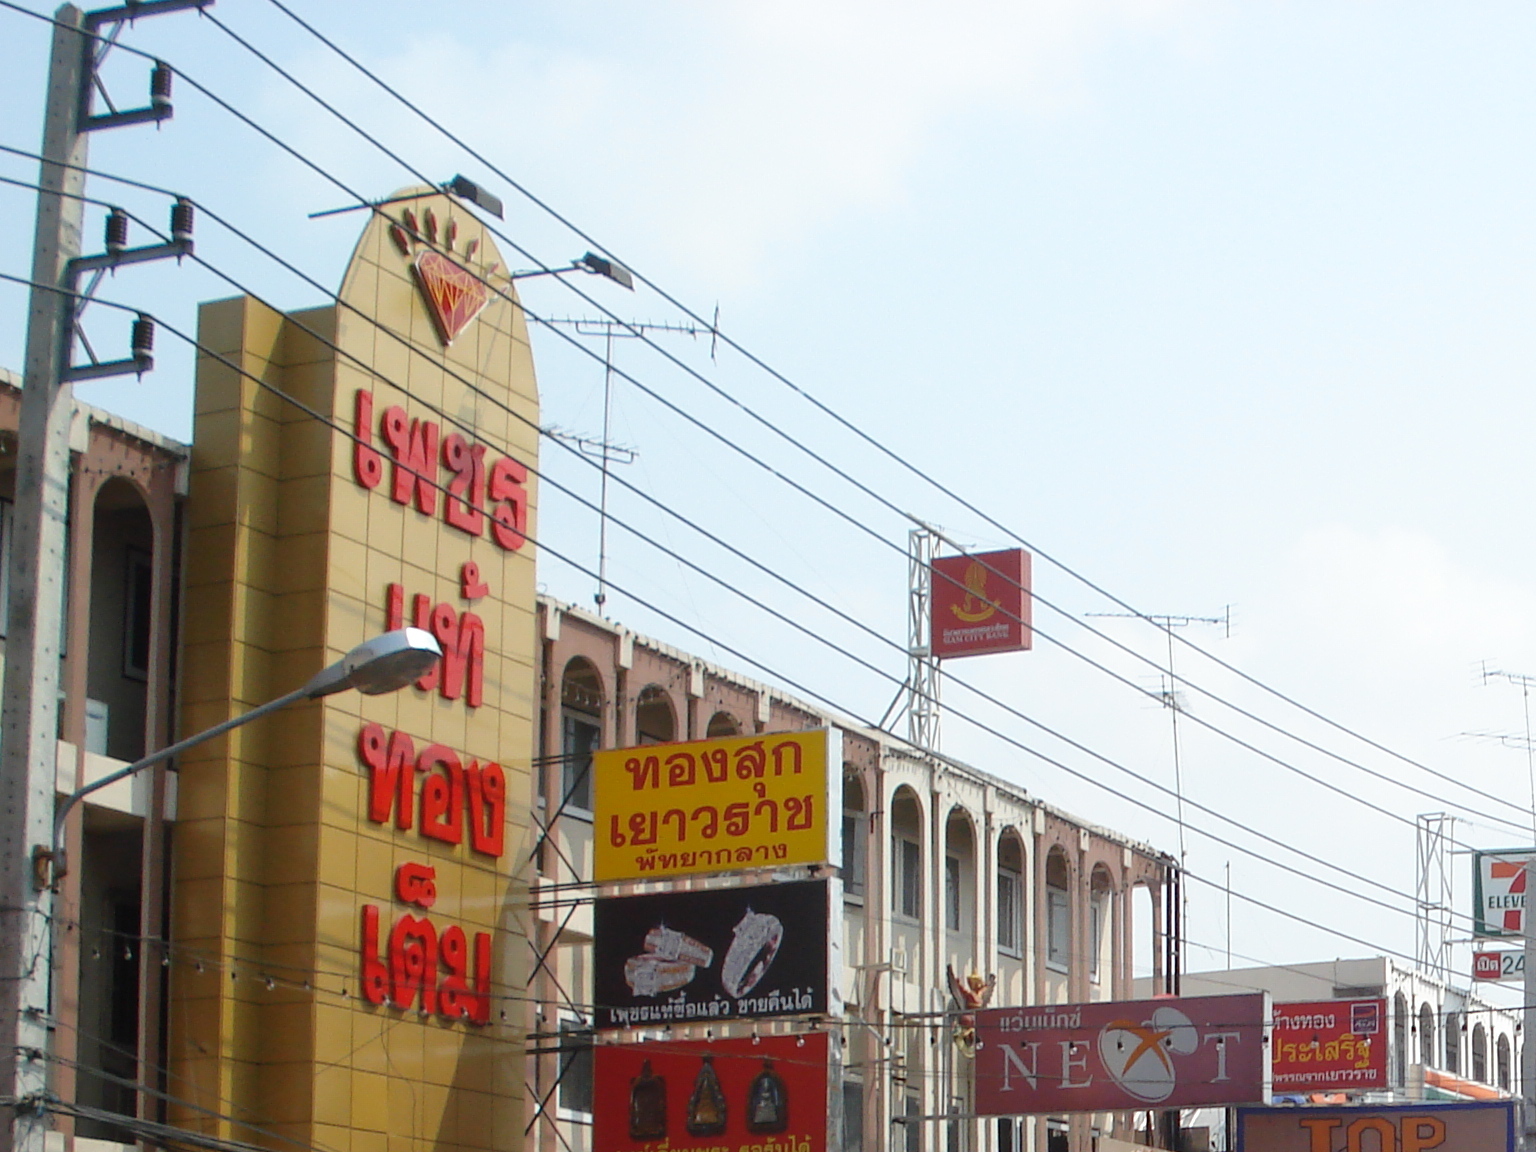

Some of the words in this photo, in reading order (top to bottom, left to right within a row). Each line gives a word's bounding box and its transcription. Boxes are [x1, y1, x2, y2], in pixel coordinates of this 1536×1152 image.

[353, 388, 528, 551] เพชร
[358, 722, 506, 858] ทอง
[625, 741, 802, 798] ทองสุก
[610, 795, 813, 848] เยาวราช
[635, 843, 787, 871] พัทยากลาง
[1488, 895, 1527, 909] ELEVE
[1477, 956, 1499, 971] เปิด
[1503, 955, 1526, 975] 24
